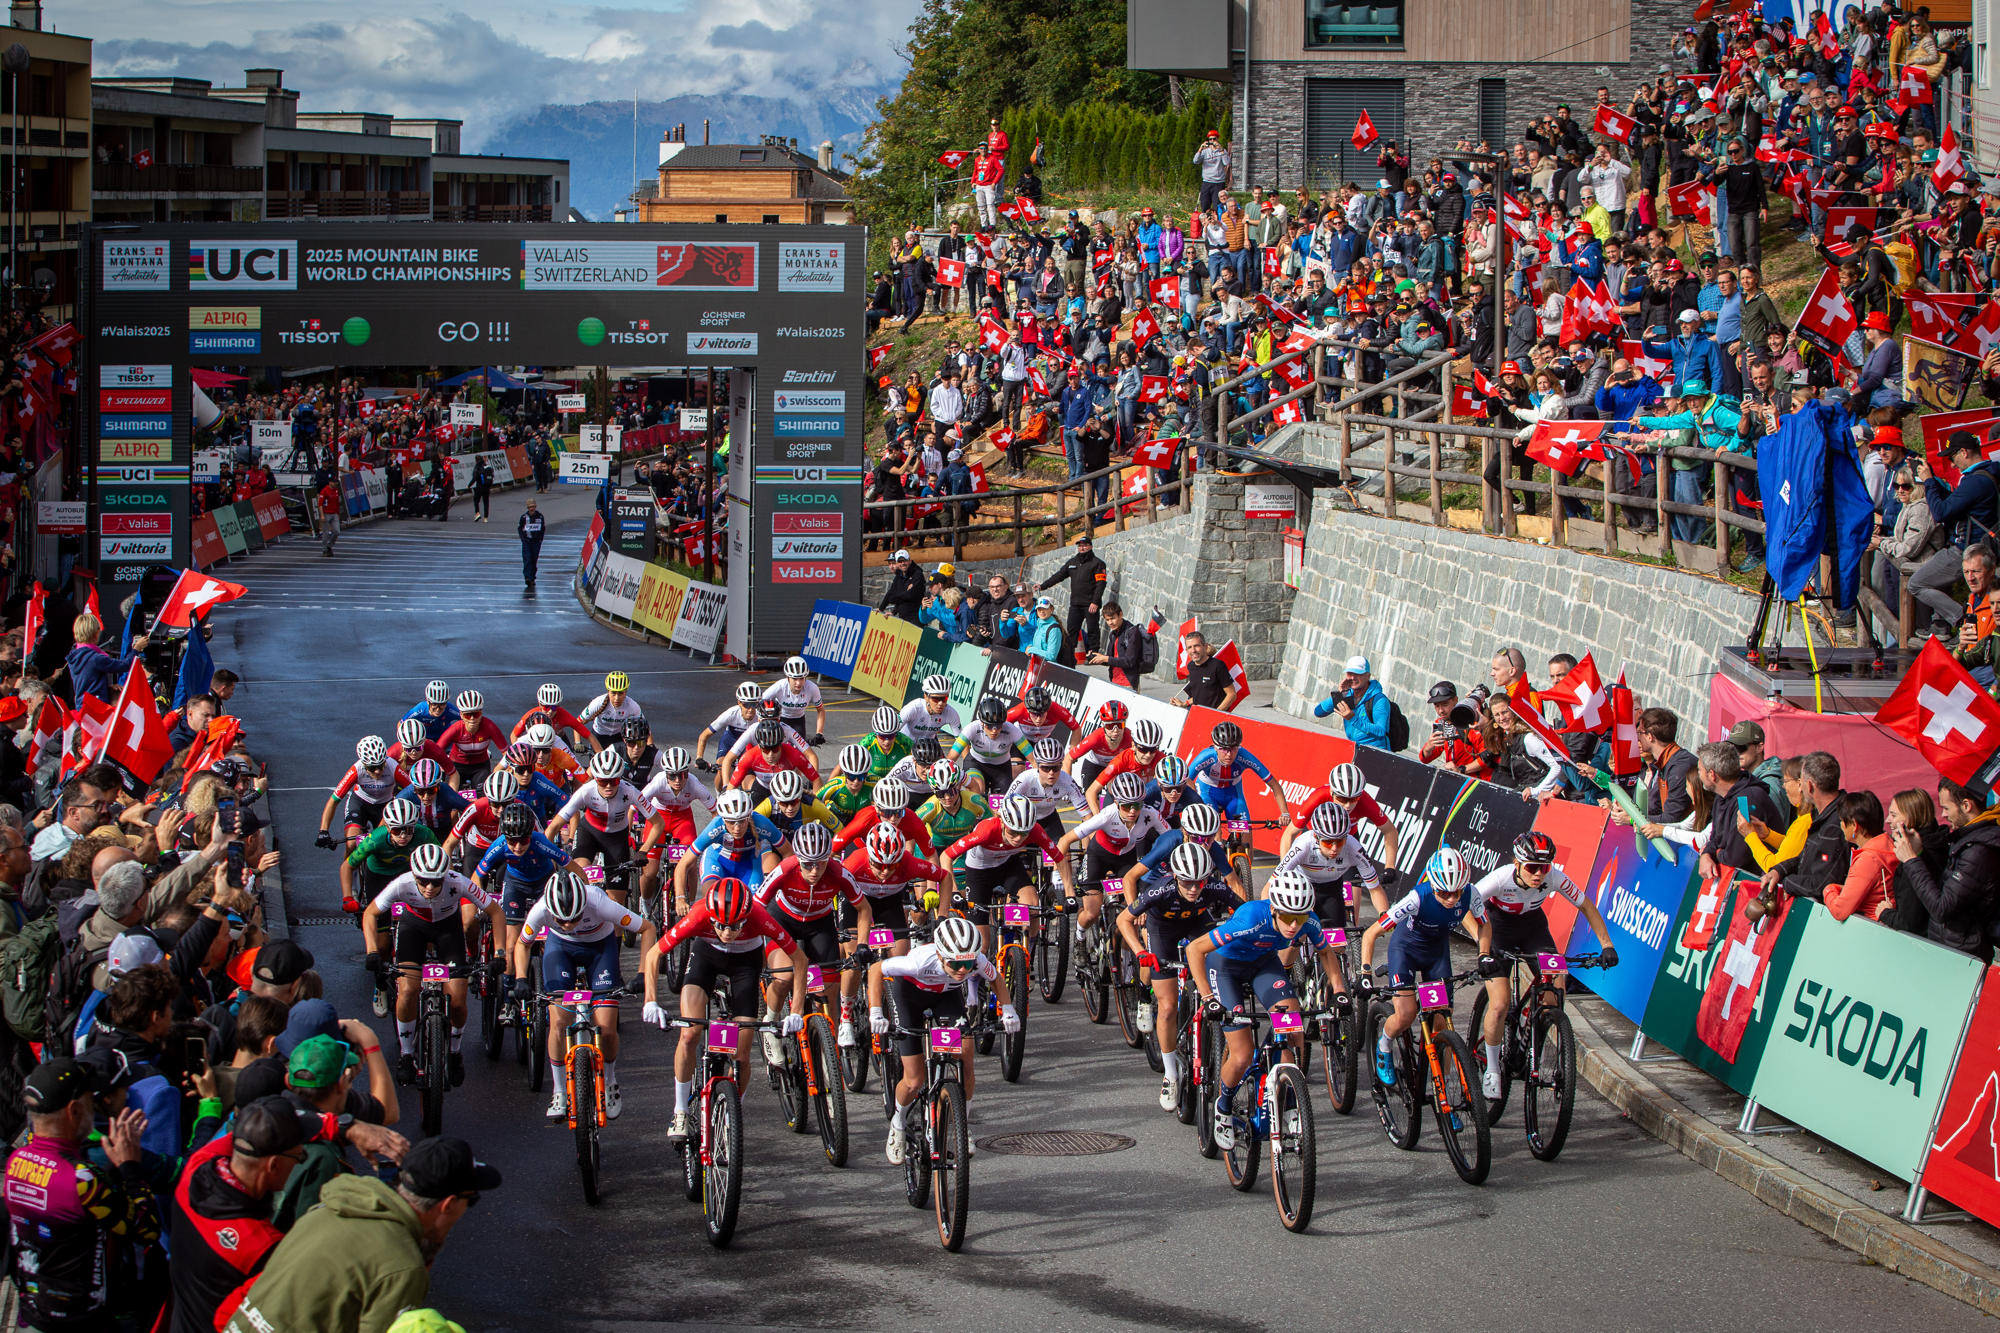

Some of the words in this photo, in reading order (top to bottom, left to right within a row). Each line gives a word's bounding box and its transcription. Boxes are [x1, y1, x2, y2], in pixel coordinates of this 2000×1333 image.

[109, 247, 146, 256] CRANS
[306, 249, 343, 263] 2025
[347, 249, 438, 263] MOUNTAIN
[442, 249, 478, 263] BIKE
[534, 248, 588, 263] VALAIS
[785, 249, 821, 258] CRANS
[109, 258, 164, 267] MONTANA
[207, 248, 289, 281] UCI
[785, 259, 839, 269] MONTANA
[111, 269, 160, 283] Absolutely
[306, 267, 368, 281] WORLD
[371, 267, 512, 281] CHAMPIONSHIPS
[534, 267, 648, 283] SWITZERLAND
[786, 270, 834, 285] Absolutely
[203, 311, 248, 327] ALPIQ
[702, 311, 746, 320] OCHSNER
[700, 319, 730, 327] SPORT
[101, 325, 171, 338] #Valais2025
[438, 321, 480, 342] GO
[488, 322, 510, 342] !!!
[776, 326, 845, 339] #Valais2025
[194, 337, 256, 349] SHIMANO
[279, 332, 340, 344] TISSOT
[608, 332, 669, 344] TISSOT
[707, 336, 752, 350] vittoria
[782, 370, 838, 383] Santini
[790, 395, 841, 406] swisscom
[456, 410, 474, 418] 75m
[689, 415, 708, 423] 75m
[105, 421, 167, 431] SHIMANO
[779, 421, 840, 431] SHIMANO
[259, 428, 282, 437] 50m
[113, 442, 160, 459] ALPIQ
[789, 443, 832, 451] OCHSNER
[786, 450, 816, 458] SPORT
[571, 463, 600, 474] 25m
[121, 469, 150, 481] UCI
[794, 469, 822, 480] UCI
[566, 477, 603, 485] SHIMANO
[616, 506, 650, 516] START
[129, 519, 159, 529] Valais
[800, 518, 830, 528] Valais
[121, 543, 167, 555] vittoria
[793, 542, 838, 553] vittoria
[117, 567, 149, 575] OCHSN
[778, 567, 836, 579] ValJob
[650, 581, 684, 632] ALPIQ
[804, 612, 862, 666] SHIMANO
[856, 628, 886, 688] ALPIQ
[1469, 802, 1489, 832] the
[1231, 821, 1246, 830] 32
[671, 848, 685, 858] 28
[1459, 836, 1501, 872] rainbow
[586, 869, 599, 879] 27
[1108, 881, 1122, 890] 18
[1148, 882, 1176, 898] Cofidis
[1012, 909, 1022, 919] 2
[1394, 902, 1416, 920] CIC
[1607, 880, 1670, 951] swisscom
[874, 933, 887, 943] 11
[1327, 932, 1336, 942] 7
[1548, 957, 1558, 968] 6
[427, 967, 445, 977] 19
[572, 992, 583, 1001] 8
[1428, 989, 1439, 1004] 3
[1281, 1013, 1292, 1025] 4
[720, 1029, 728, 1044] 1
[940, 1031, 951, 1044] 5
